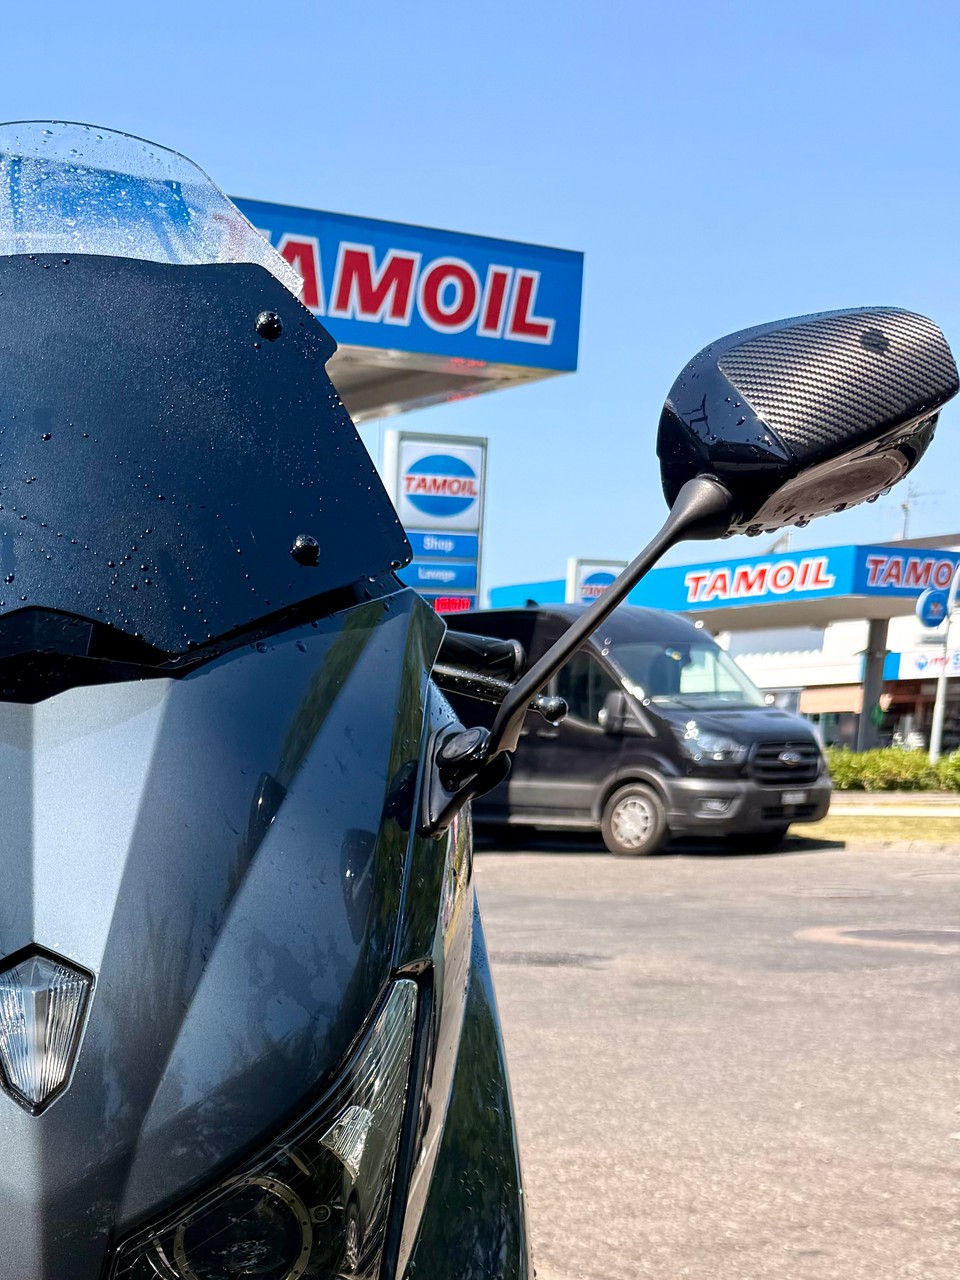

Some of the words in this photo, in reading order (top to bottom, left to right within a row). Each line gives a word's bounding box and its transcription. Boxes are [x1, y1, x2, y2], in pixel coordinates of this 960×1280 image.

[404, 475, 478, 497] TAMOIL
[685, 556, 836, 602] TAMOIL
[866, 555, 960, 590] TAMO
